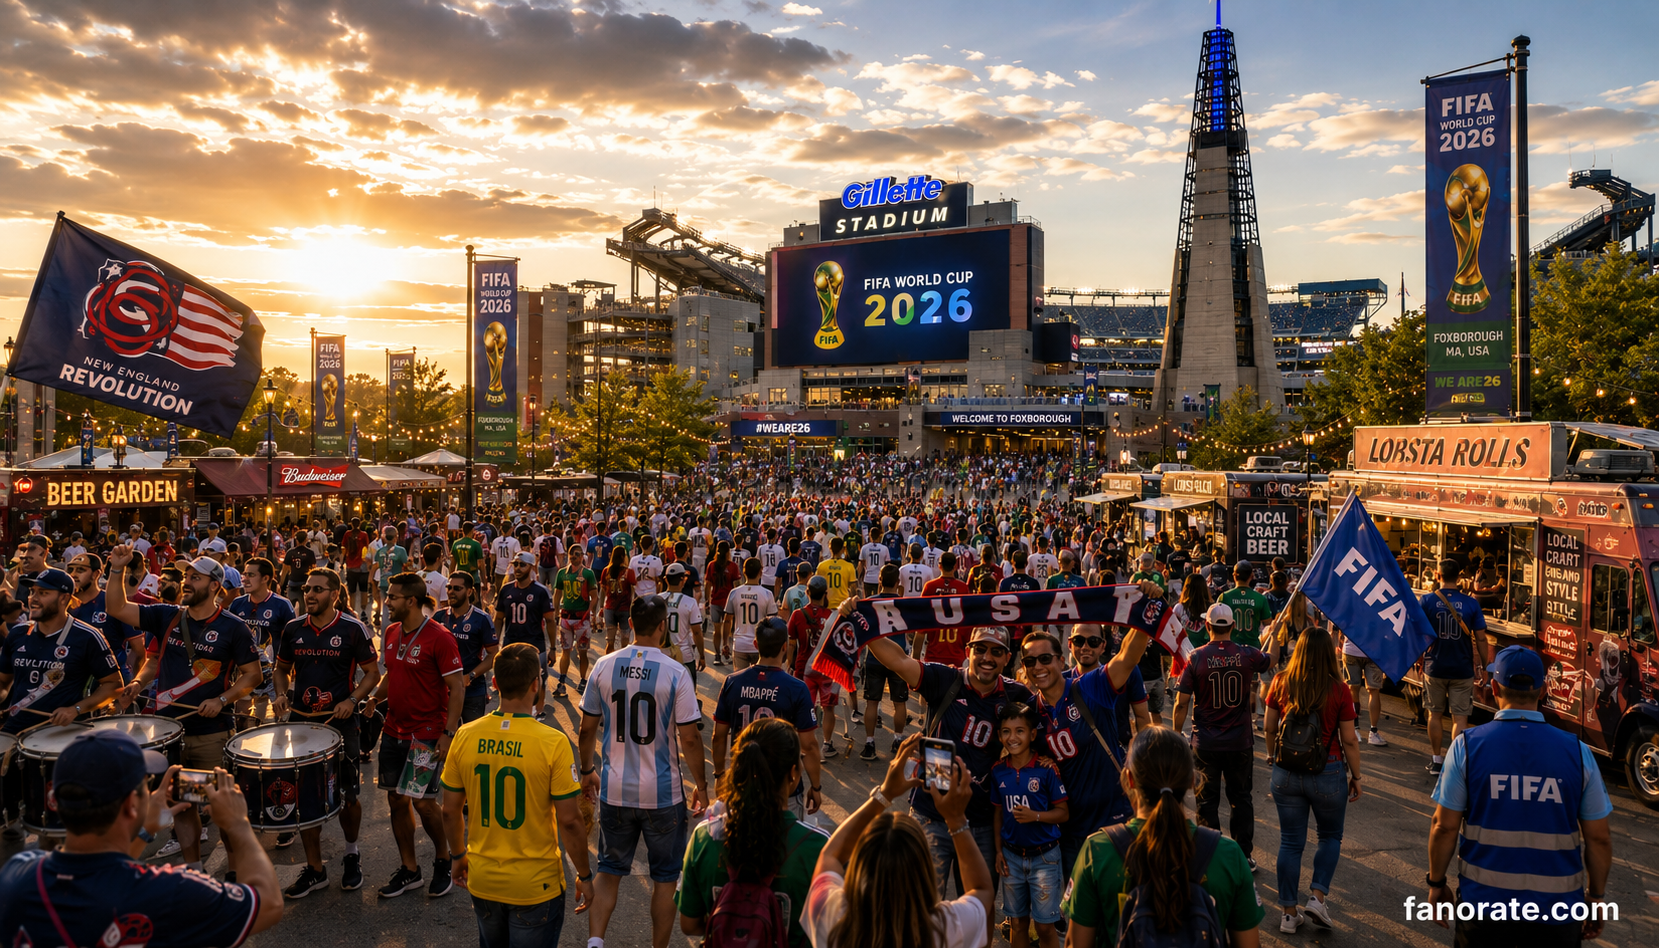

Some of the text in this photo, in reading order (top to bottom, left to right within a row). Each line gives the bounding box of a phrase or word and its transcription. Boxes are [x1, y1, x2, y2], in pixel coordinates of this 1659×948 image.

[1441, 92, 1494, 117] FIFA
[1440, 114, 1496, 131] WORLD CUP
[1439, 127, 1496, 153] 2026
[841, 174, 943, 210] Gillette
[835, 206, 948, 234] STADIUM
[481, 272, 511, 287] FIFA
[864, 270, 974, 290] FIFA WORLD CUP
[480, 298, 512, 314] 2026
[864, 288, 973, 327] 2026
[819, 334, 839, 345] FIFA
[1433, 330, 1503, 343] FOXBOROUGH
[320, 343, 340, 353] FIFA
[1445, 345, 1490, 358] MA, USA
[319, 359, 341, 369] 2026
[83, 356, 180, 392] NEW ENGLAND
[1434, 376, 1455, 388] WE
[59, 363, 194, 416] REVOLUTION
[755, 422, 811, 433] #WEARE26
[952, 414, 1072, 423] WELCOME TO FOXBOROUGH
[1368, 436, 1531, 470] LOBSTA ROLLS
[281, 467, 347, 484] Budweiser
[47, 481, 96, 506] BEER
[102, 480, 178, 504] GARDEN
[1245, 511, 1290, 525] LOCAL
[1246, 526, 1289, 538] CRAFT
[1547, 532, 1579, 550] LOCAL
[1246, 539, 1289, 555] BEER
[827, 572, 841, 589] 10
[1334, 547, 1408, 638] FIFA
[510, 602, 527, 625] 10
[740, 602, 758, 625] 10
[619, 665, 652, 681] MESSI
[740, 686, 779, 702] MBAPPÉ
[1208, 670, 1243, 709] 10
[611, 689, 657, 746] 10
[961, 714, 994, 749] 10
[477, 738, 524, 758] BRASIL
[1047, 730, 1077, 761] 10
[474, 763, 526, 831] 10
[1489, 773, 1563, 804] FIFA
[1005, 794, 1031, 813] USA
